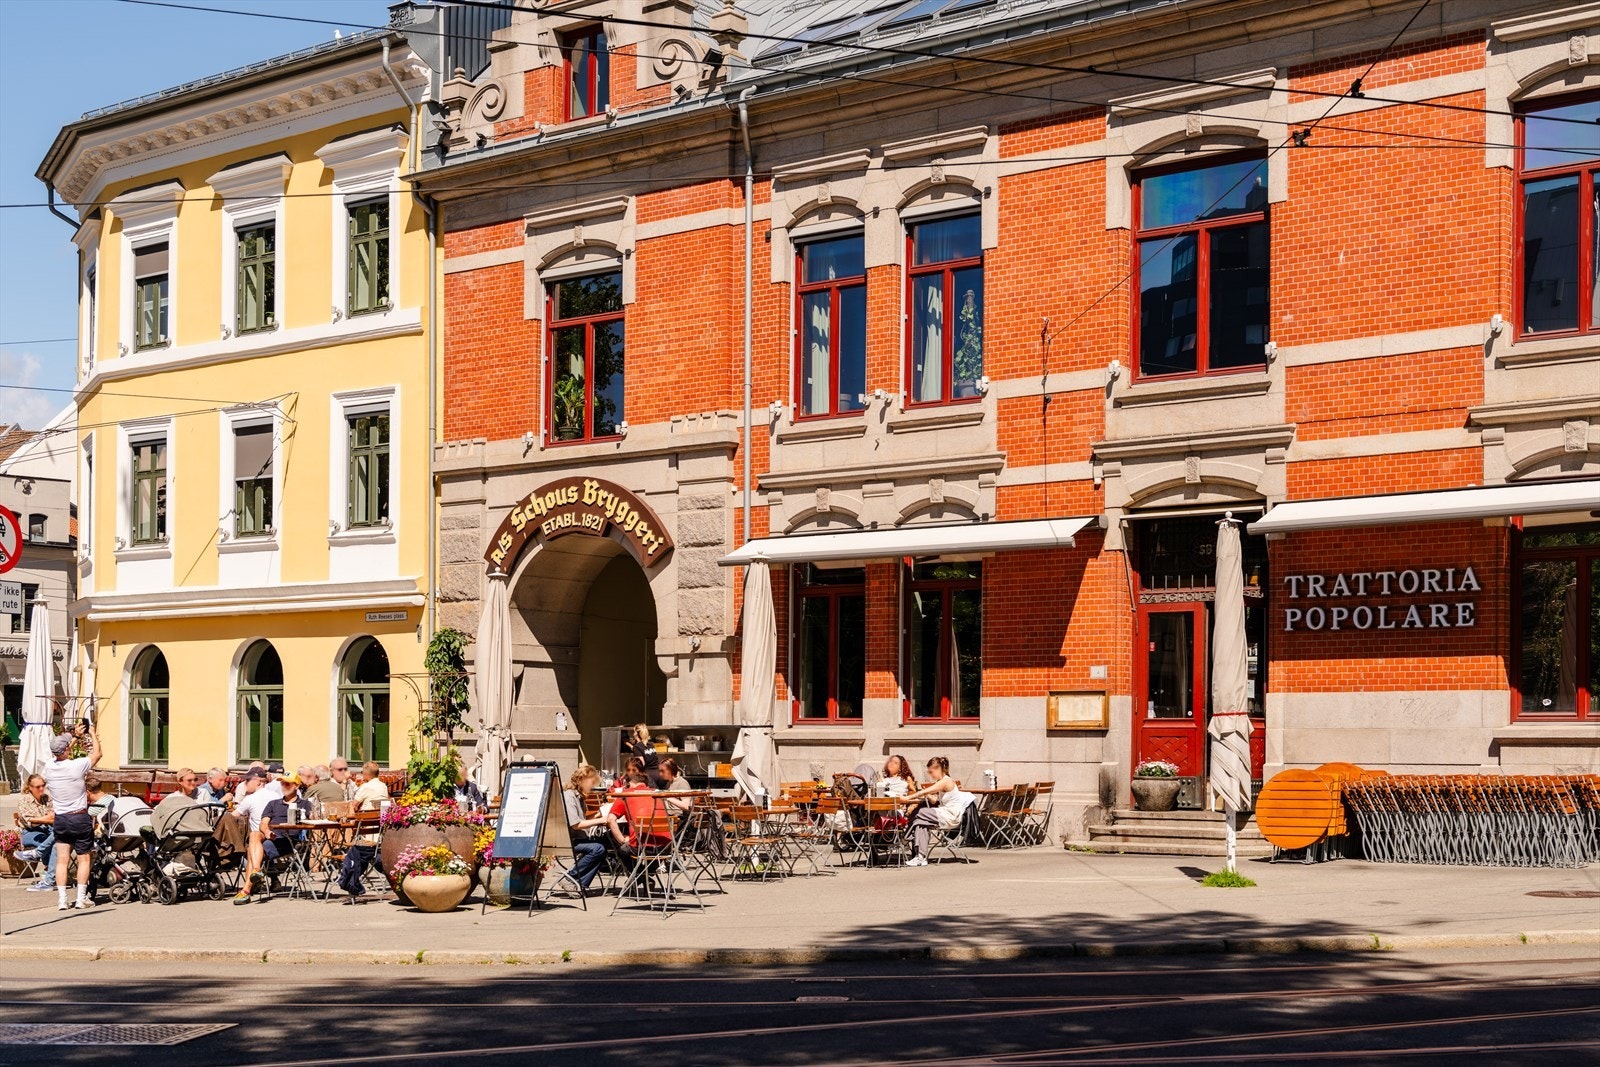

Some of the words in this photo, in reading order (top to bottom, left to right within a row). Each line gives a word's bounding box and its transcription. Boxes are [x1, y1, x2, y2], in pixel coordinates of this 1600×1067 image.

[510, 485, 579, 532] Schous
[581, 478, 664, 555] Bryggeri
[4, 586, 20, 596] ikke
[1284, 566, 1481, 598] TRATTORIA
[2, 600, 18, 609] rute
[1284, 602, 1475, 631] POPOLARE
